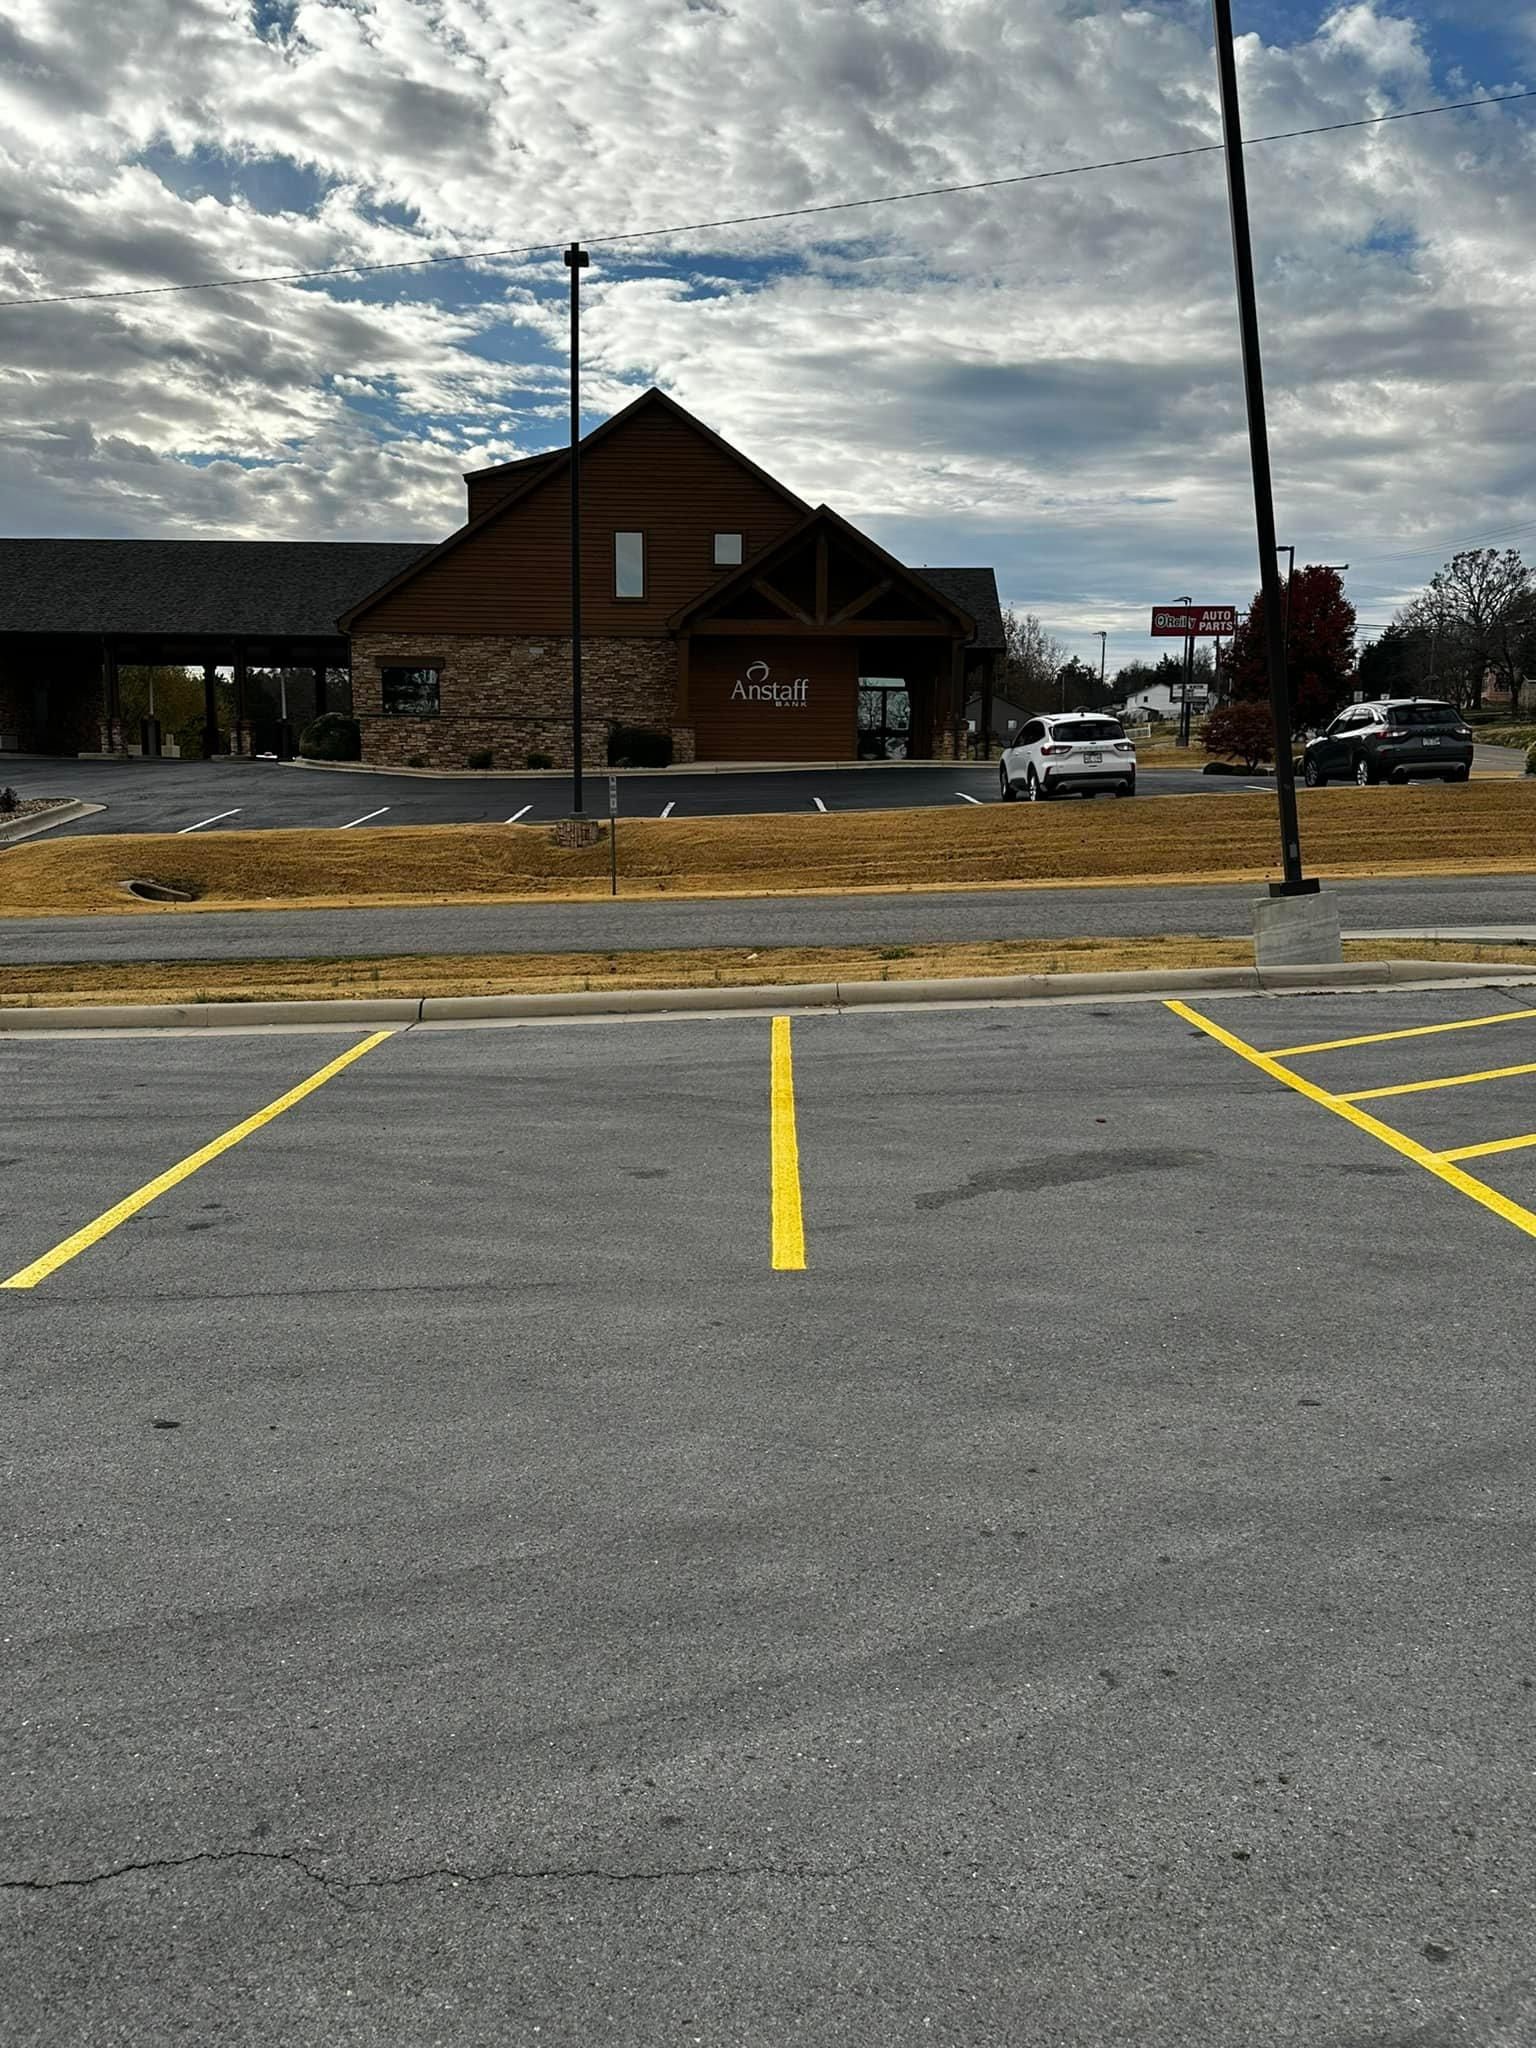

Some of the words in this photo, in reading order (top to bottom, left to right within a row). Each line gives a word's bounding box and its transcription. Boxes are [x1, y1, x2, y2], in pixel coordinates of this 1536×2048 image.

[1202, 610, 1231, 620] AUTO
[1199, 621, 1233, 631] PARTS
[731, 679, 809, 700] Anstaff
